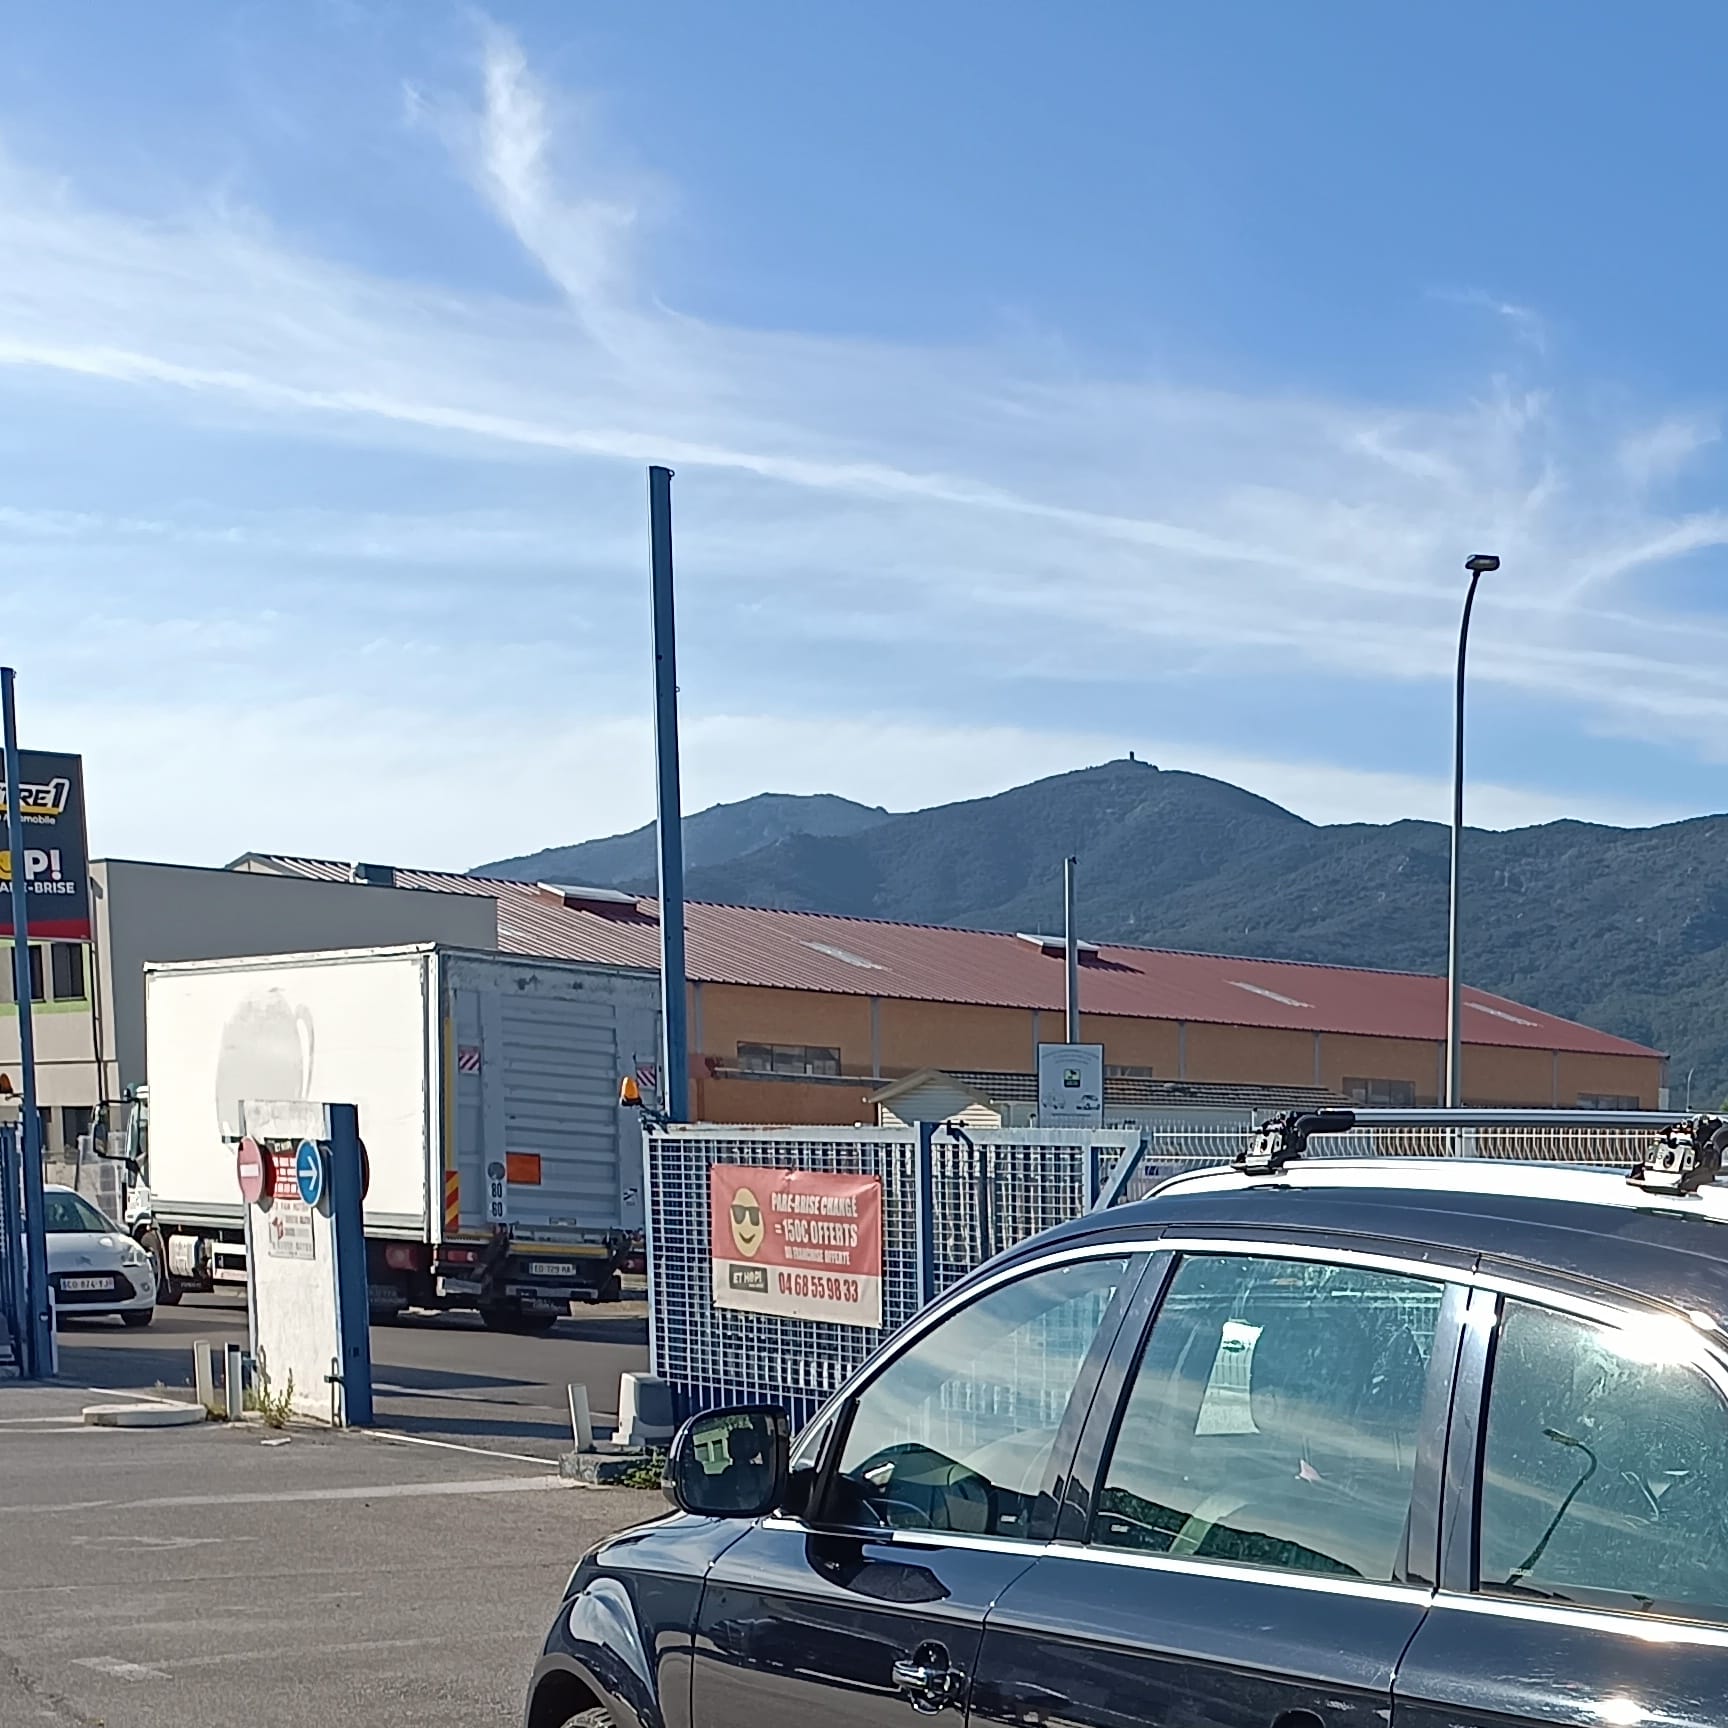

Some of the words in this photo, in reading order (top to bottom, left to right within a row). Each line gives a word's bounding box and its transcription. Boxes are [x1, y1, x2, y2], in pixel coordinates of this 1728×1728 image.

[491, 1182, 503, 1198] 80
[491, 1201, 503, 1217] 60
[771, 1192, 819, 1214] PARE-BRISE
[820, 1194, 858, 1217] CHANGÉ
[810, 1221, 858, 1248] OFFERTS
[733, 1272, 744, 1285] ET
[778, 1272, 792, 1295] 04
[794, 1273, 809, 1297] 68
[811, 1275, 826, 1299] 55
[827, 1277, 842, 1301] 98
[843, 1279, 859, 1303] 33
